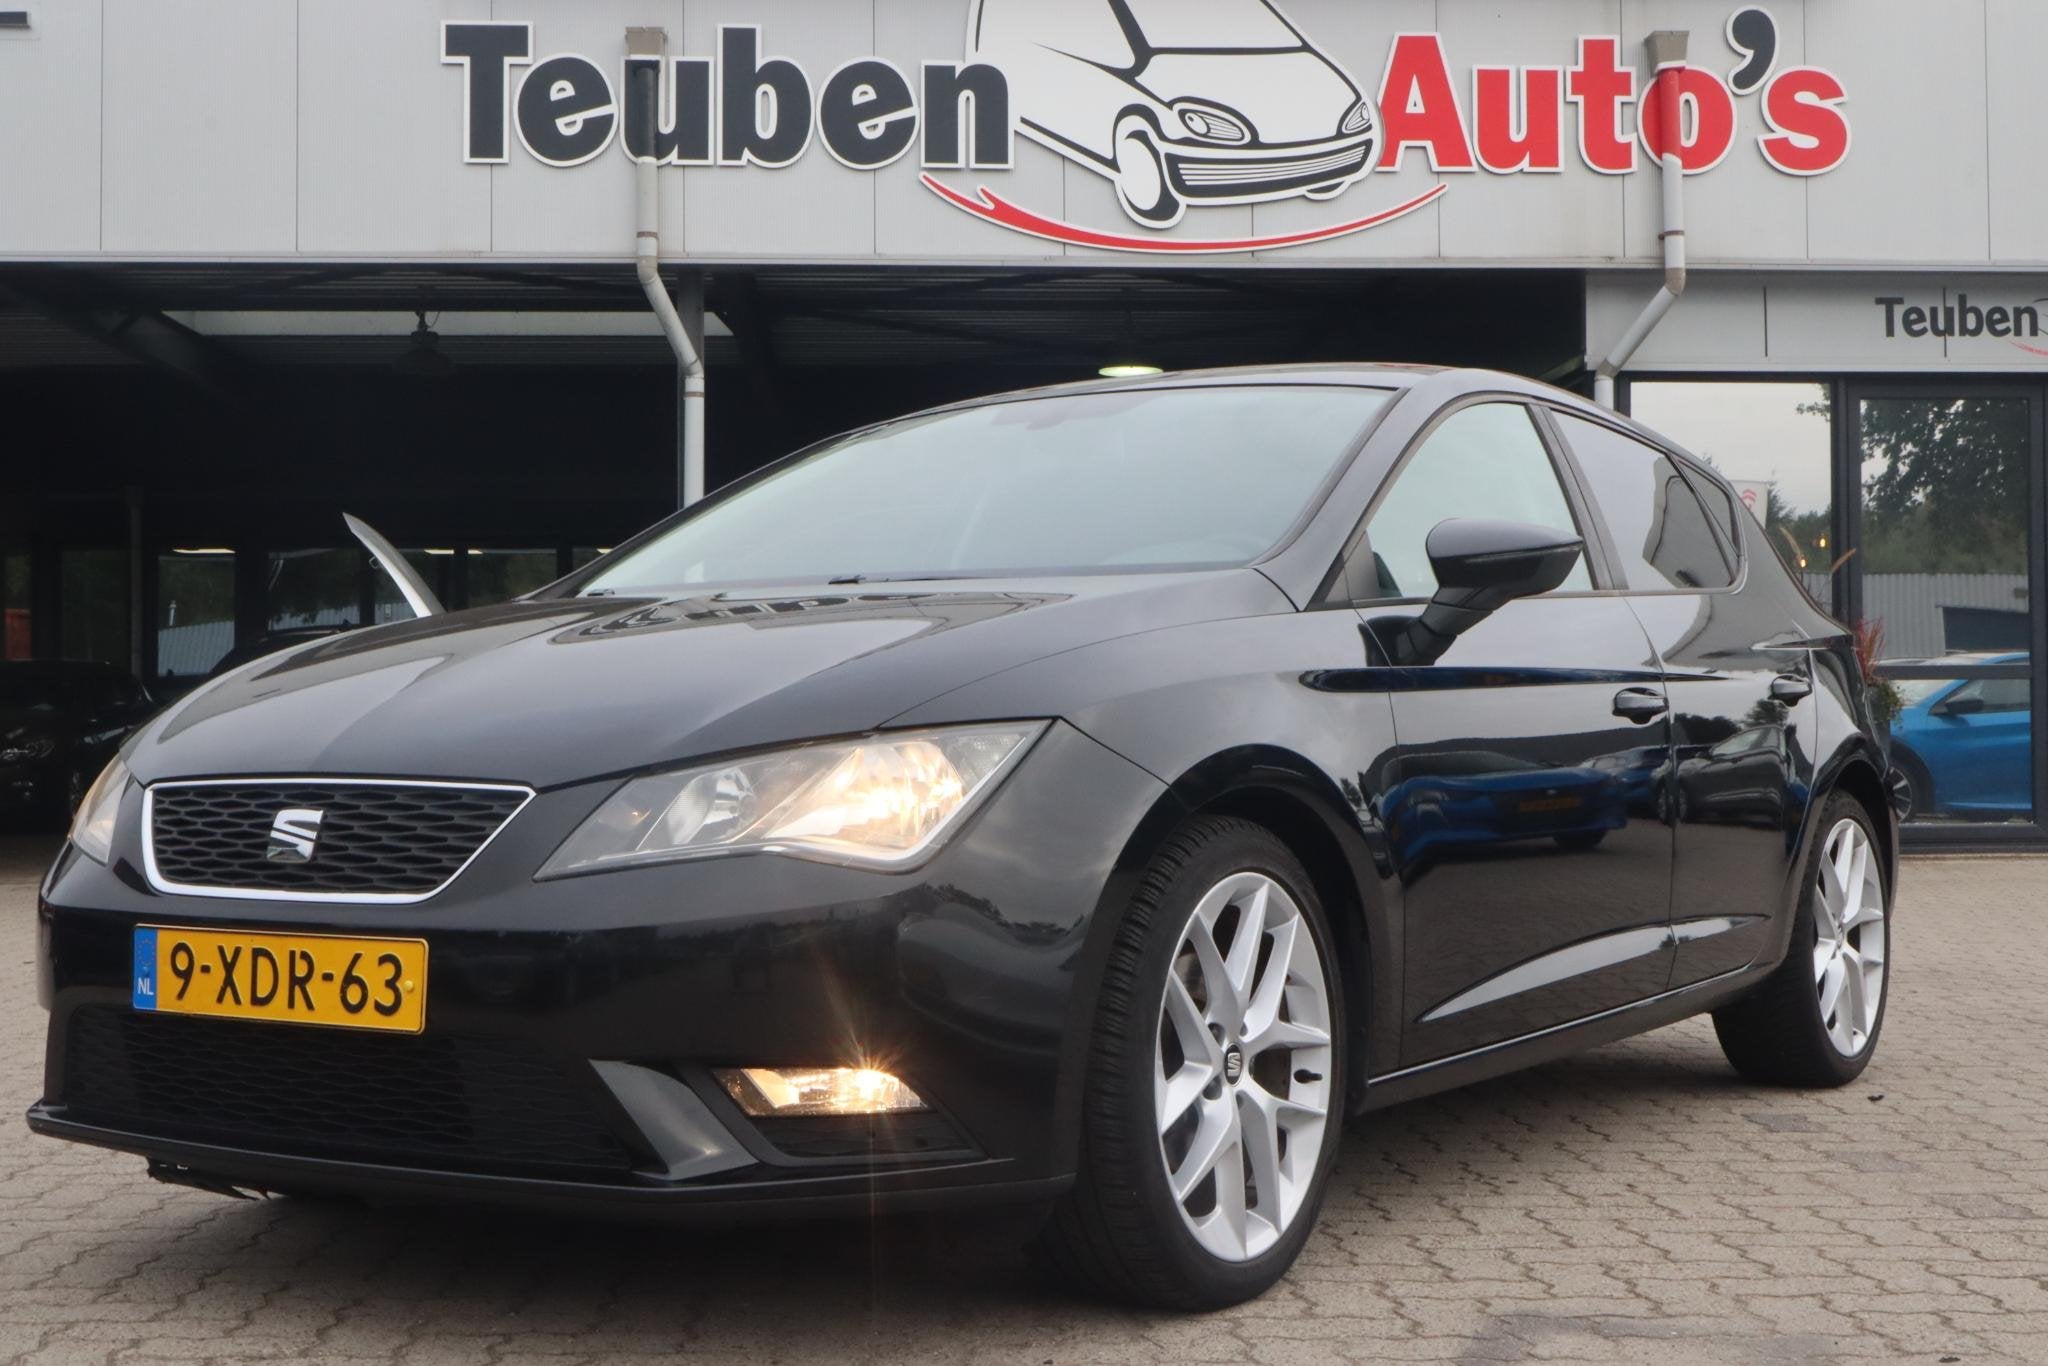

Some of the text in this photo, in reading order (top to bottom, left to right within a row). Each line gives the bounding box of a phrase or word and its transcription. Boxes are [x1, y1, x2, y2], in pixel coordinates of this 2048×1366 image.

[443, 8, 1850, 173] Teuben Auto's
[1874, 293, 2039, 338] Teuben
[137, 977, 154, 995] NL
[169, 941, 403, 1017] 9-XDR-63
